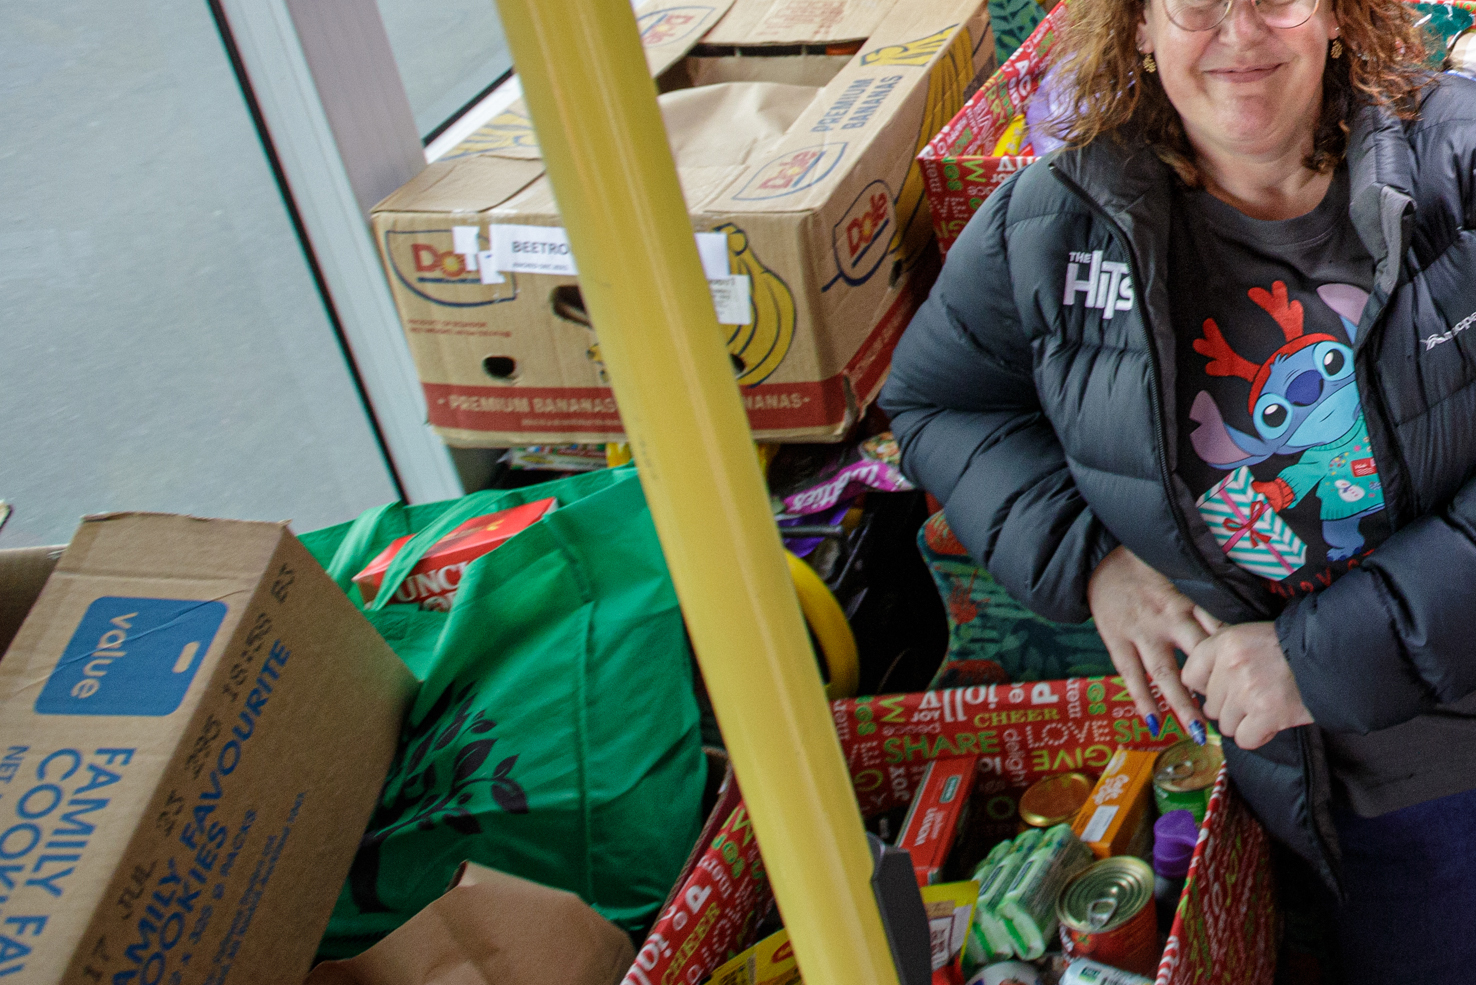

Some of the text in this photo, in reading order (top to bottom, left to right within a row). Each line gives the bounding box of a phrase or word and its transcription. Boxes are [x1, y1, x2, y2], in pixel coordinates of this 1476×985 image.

[810, 78, 877, 133] PREMIUM
[842, 74, 904, 130] BANANAS
[758, 150, 820, 191] Dole
[845, 192, 890, 258] Dole
[411, 243, 470, 278] Do
[511, 239, 570, 257] BEETRO
[1069, 251, 1093, 265] THE
[449, 394, 531, 414] PREMIUM
[69, 610, 140, 702] value
[974, 708, 1061, 729] CHEER
[1027, 720, 1112, 748] LOVE
[1113, 713, 1188, 744] SHA
[883, 729, 1002, 765] SHARE
[1031, 744, 1114, 772] GIVE
[25, 747, 138, 898] FAMILY
[112, 857, 183, 985] AMILY
[180, 638, 291, 850] FAVOURITE
[139, 821, 228, 985] OOKIES
